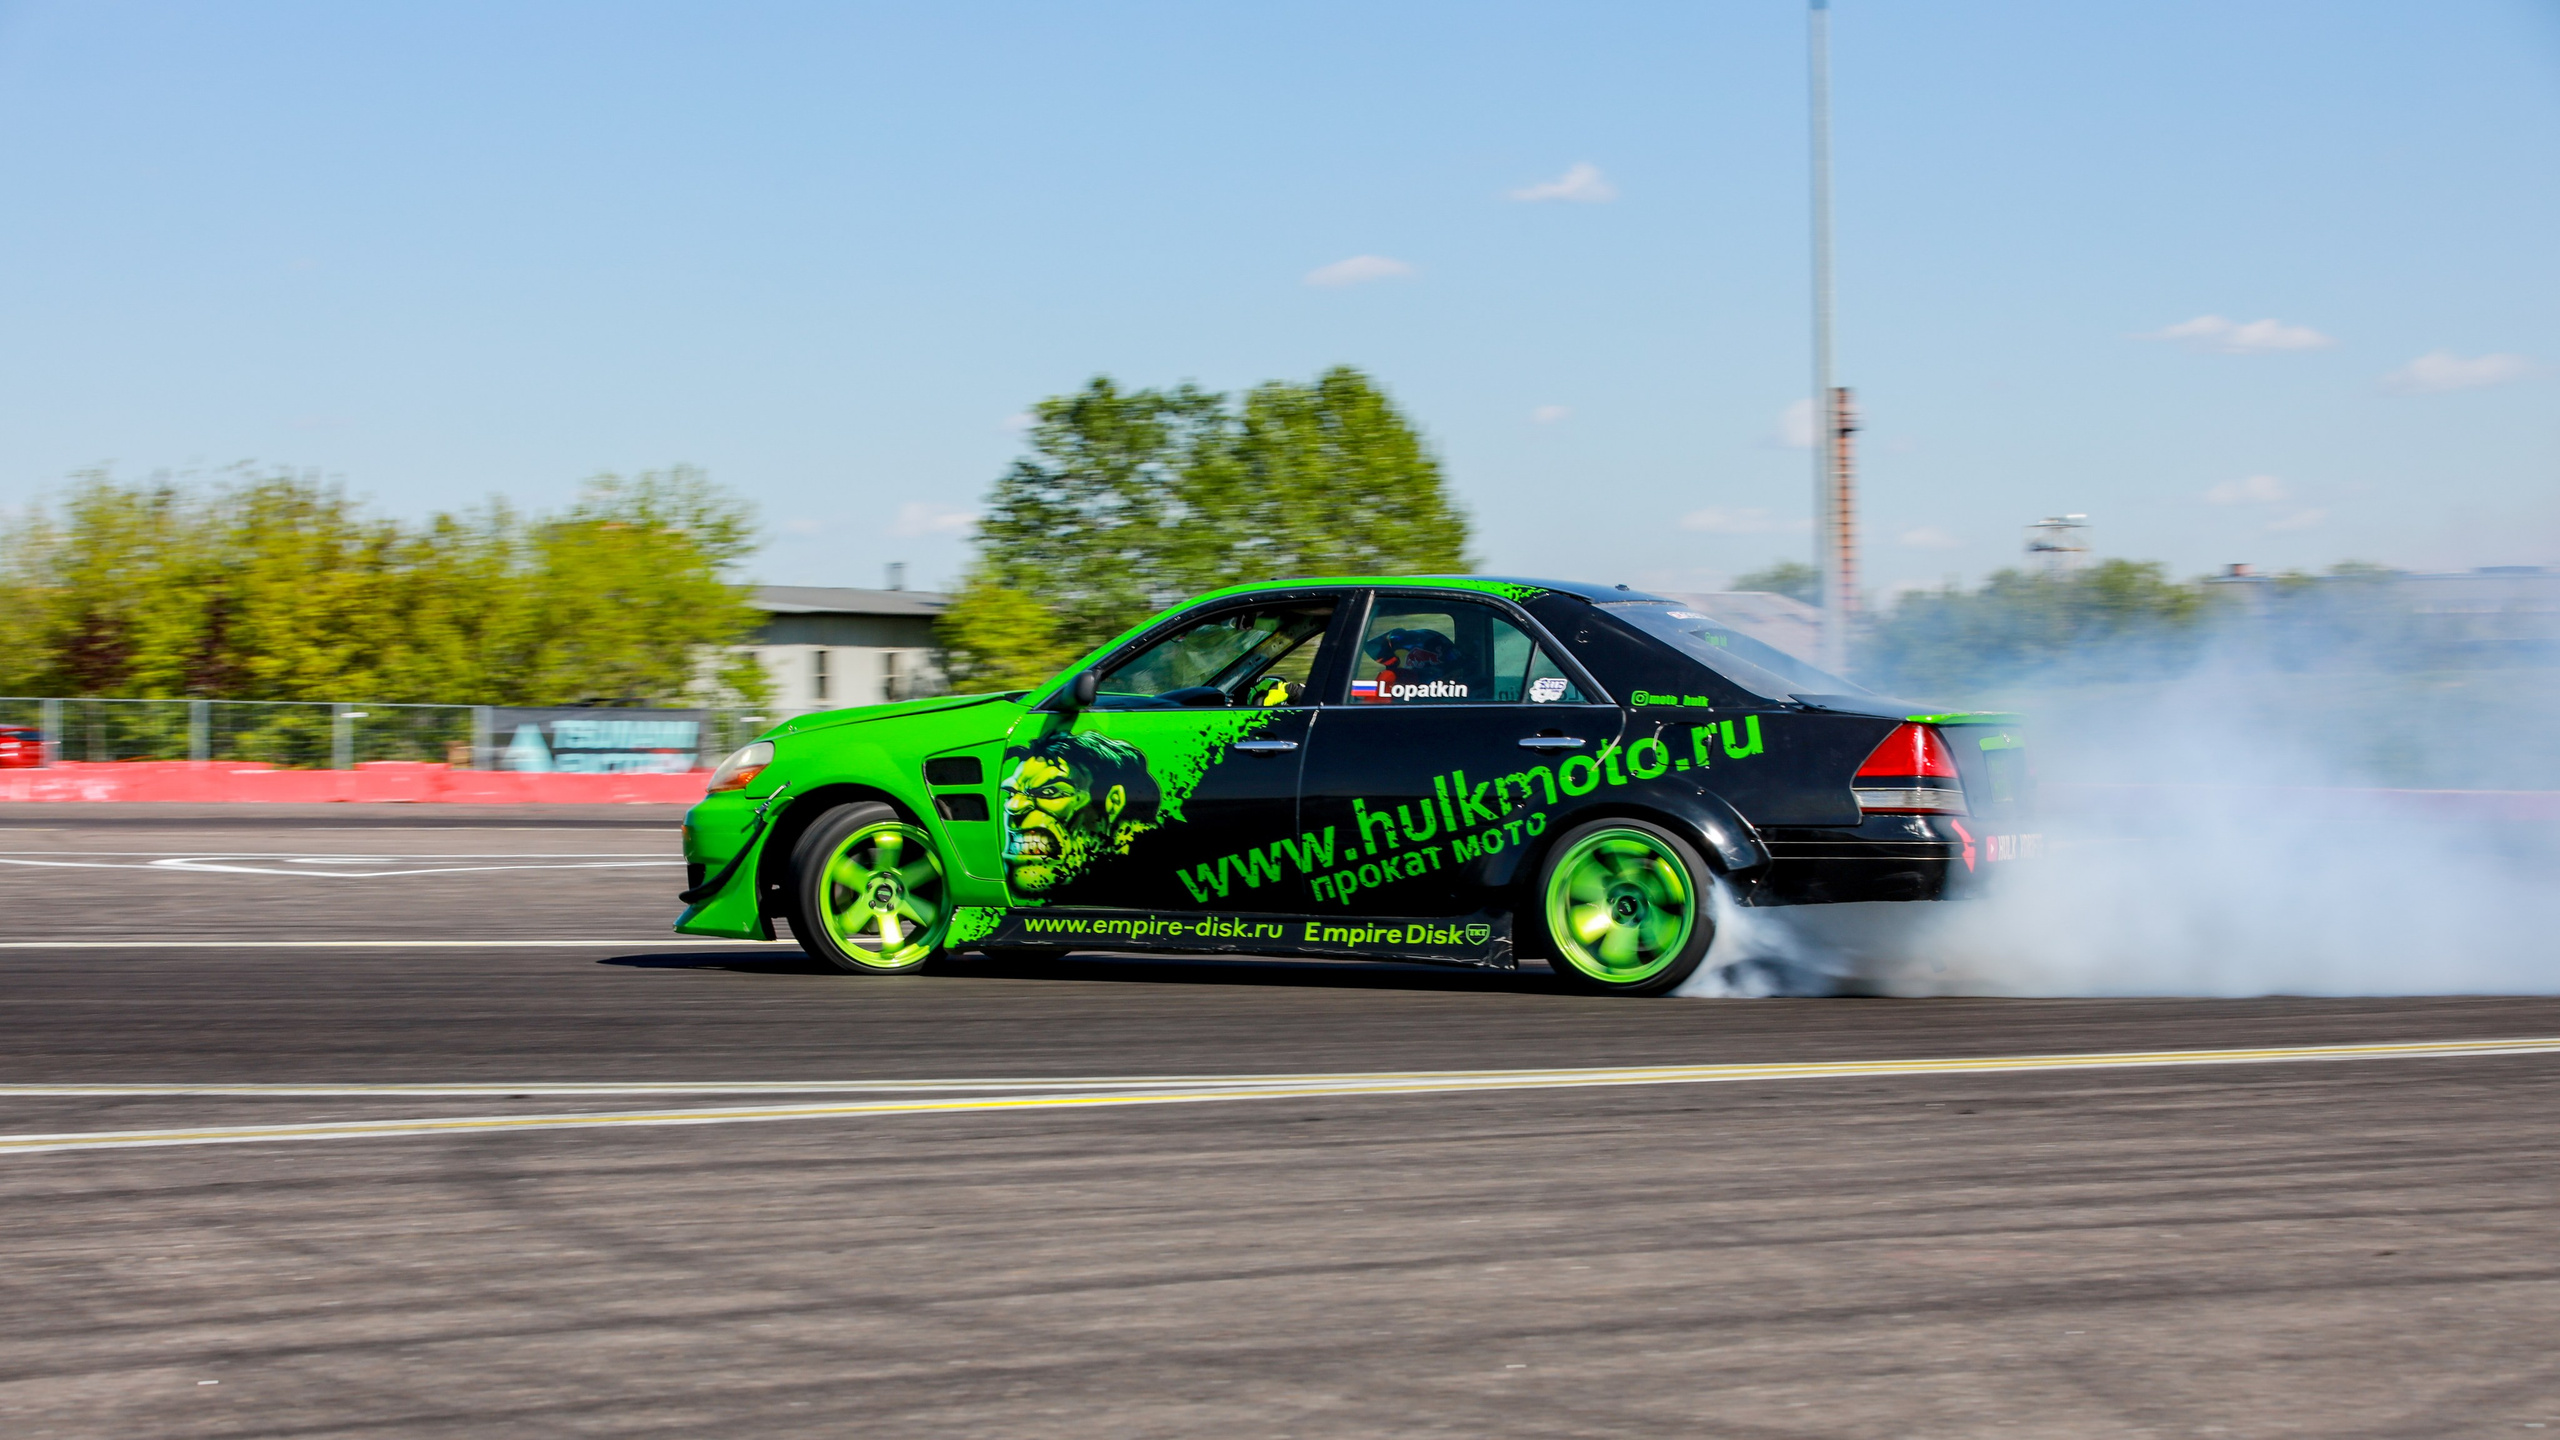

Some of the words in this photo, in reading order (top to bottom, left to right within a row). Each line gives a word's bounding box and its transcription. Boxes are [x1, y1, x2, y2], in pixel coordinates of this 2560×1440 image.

[1378, 680, 1468, 701] Lopatkin
[1176, 715, 1764, 903] www.hulkmoto.ru
[1310, 846, 1443, 905] прокат
[1452, 812, 1547, 863] мото
[1024, 915, 1284, 940] www.empire-disk.ru
[1304, 921, 1403, 947] Empire
[1405, 923, 1465, 945] Disk
